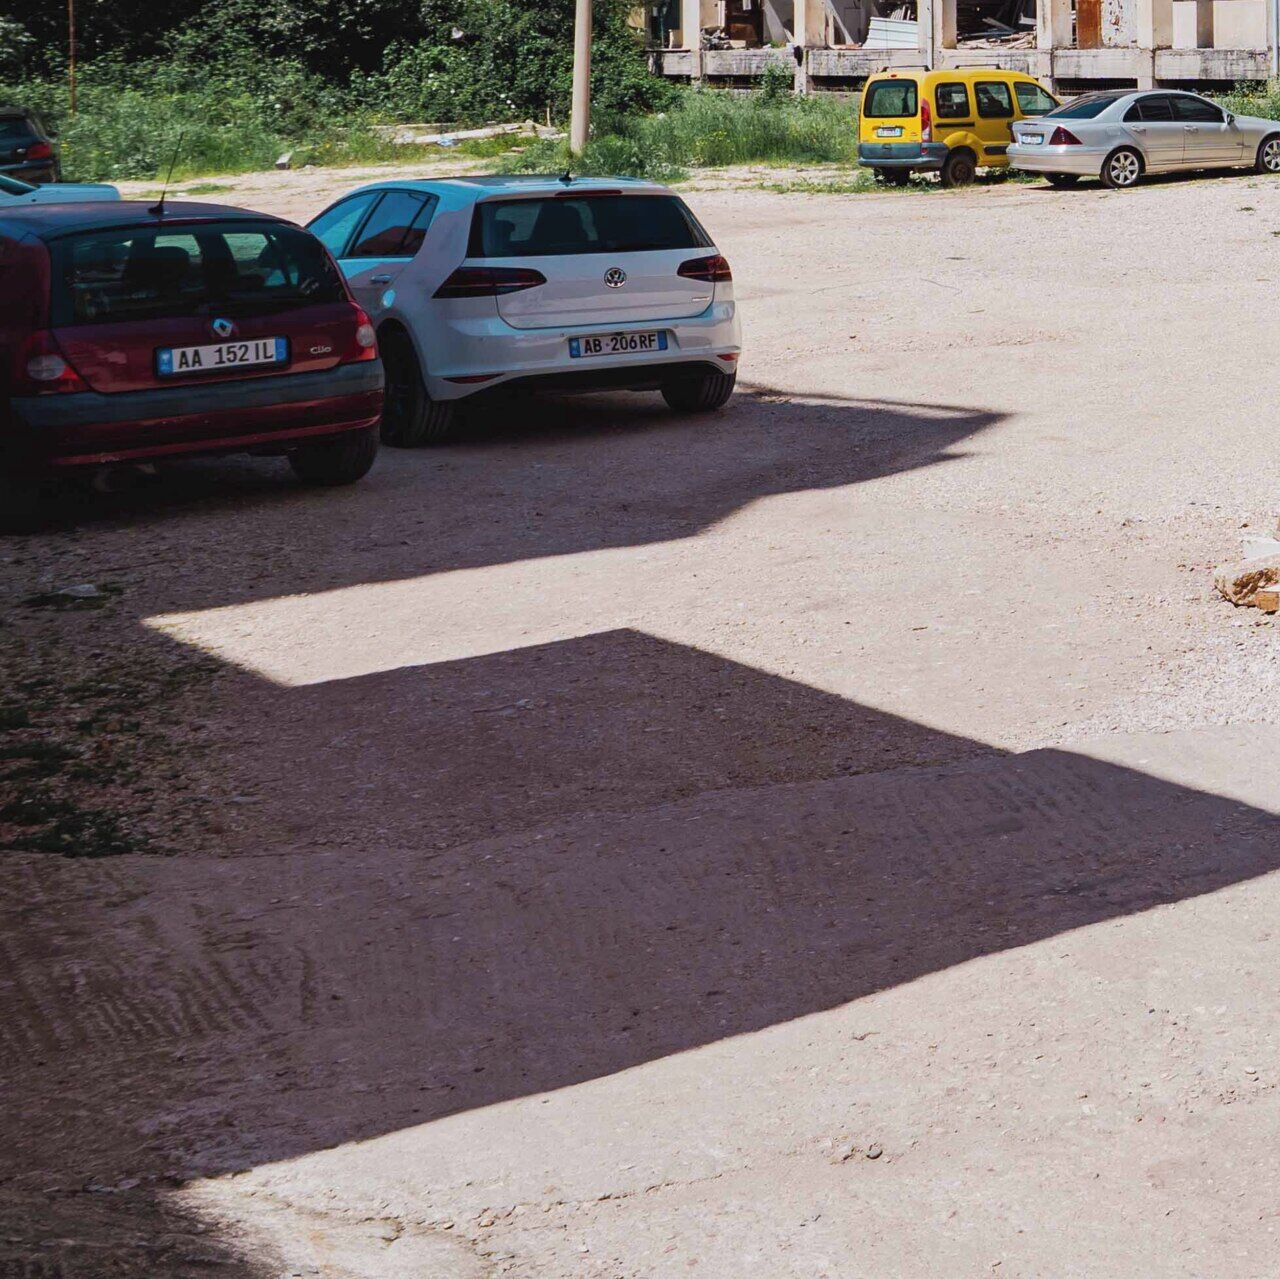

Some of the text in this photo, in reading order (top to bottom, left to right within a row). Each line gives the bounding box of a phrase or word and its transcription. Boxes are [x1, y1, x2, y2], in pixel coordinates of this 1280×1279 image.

[179, 342, 274, 369] AA 152 IL
[584, 333, 657, 354] AB 206 RF
